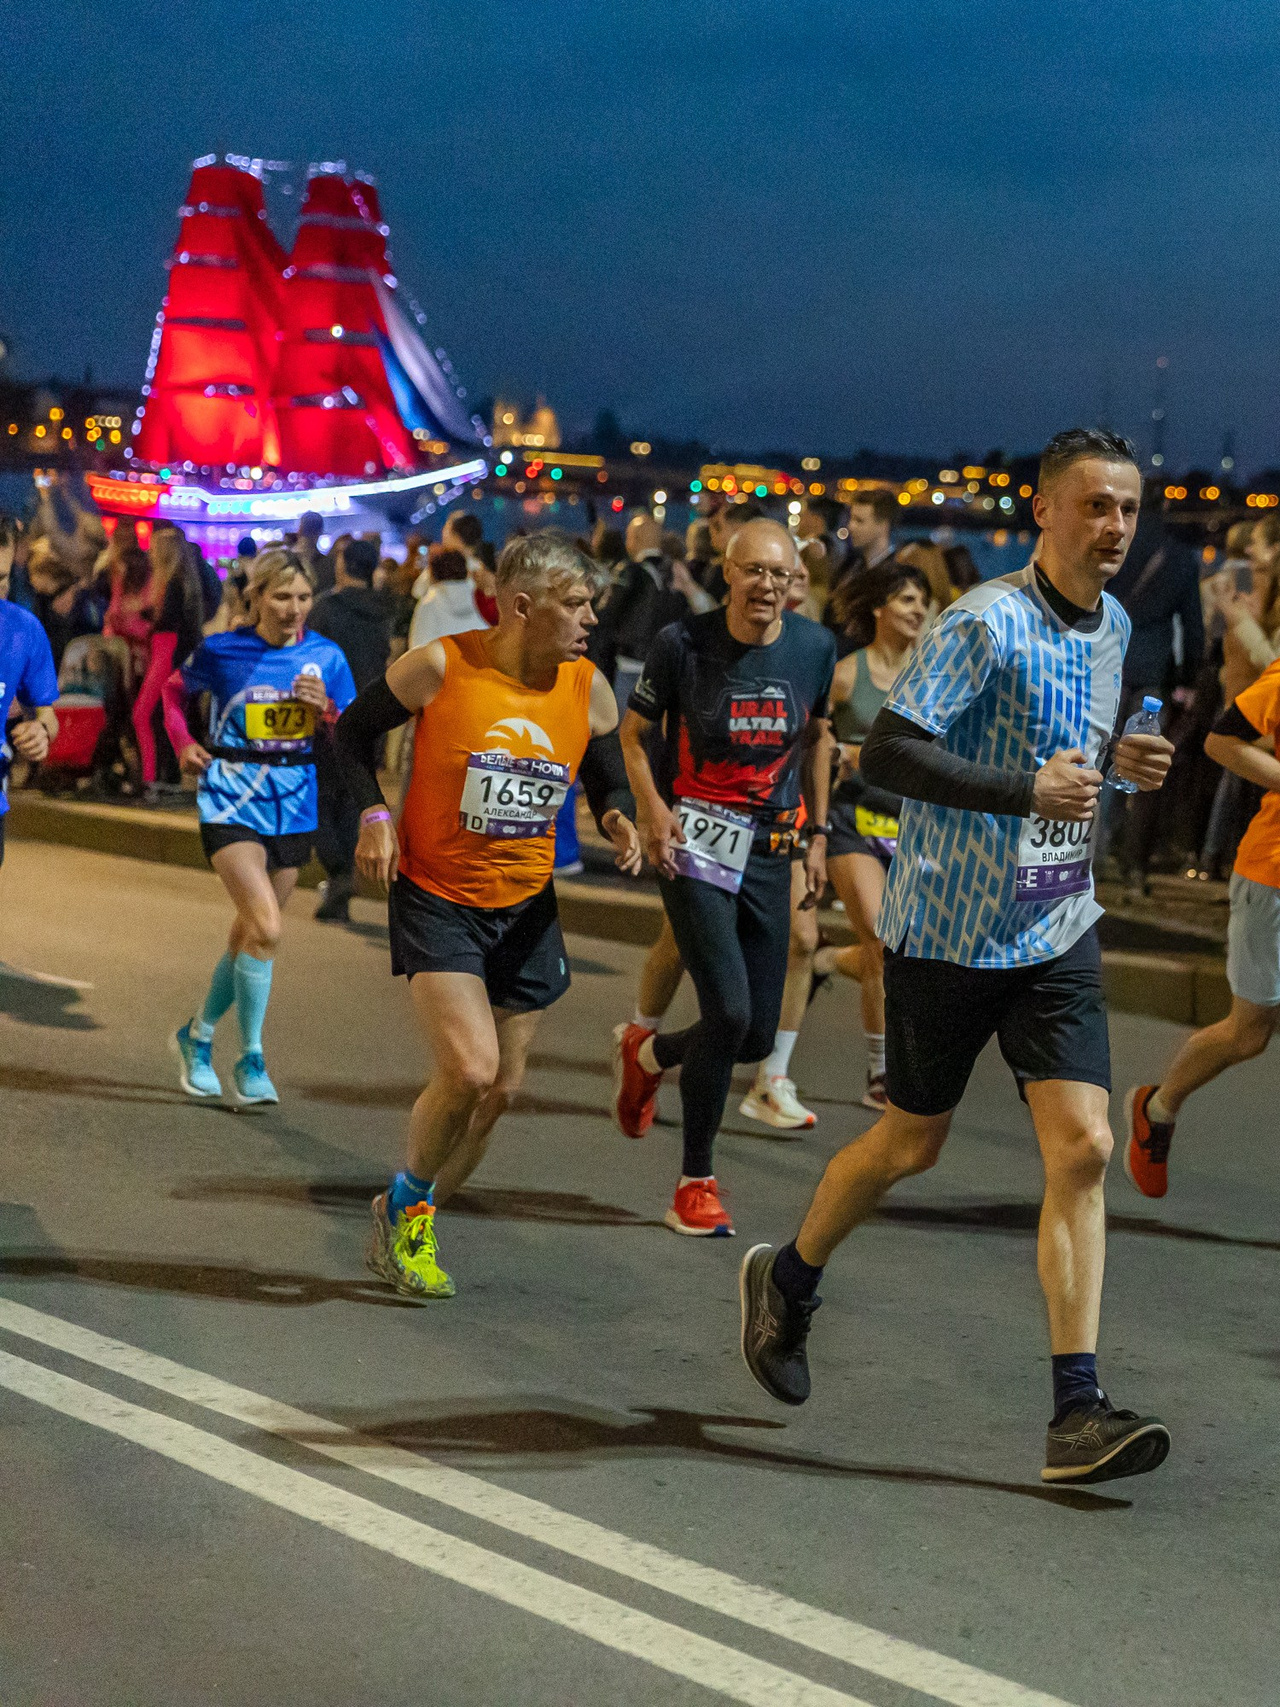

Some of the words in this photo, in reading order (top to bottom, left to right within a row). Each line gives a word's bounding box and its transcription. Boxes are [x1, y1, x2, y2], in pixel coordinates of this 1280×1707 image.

[264, 707, 306, 728] 873
[730, 700, 788, 718] URAL
[729, 716, 787, 733] ULTRA
[729, 731, 784, 746] TRAIL
[480, 754, 516, 768] БЕЛЫЕ
[480, 776, 555, 808] 1659
[483, 807, 538, 820] АЛЕКСАНДР
[471, 815, 483, 831] D
[1030, 812, 1094, 849] 3802
[678, 812, 741, 855] 1971
[1041, 848, 1083, 863] ВЛАДИМИР
